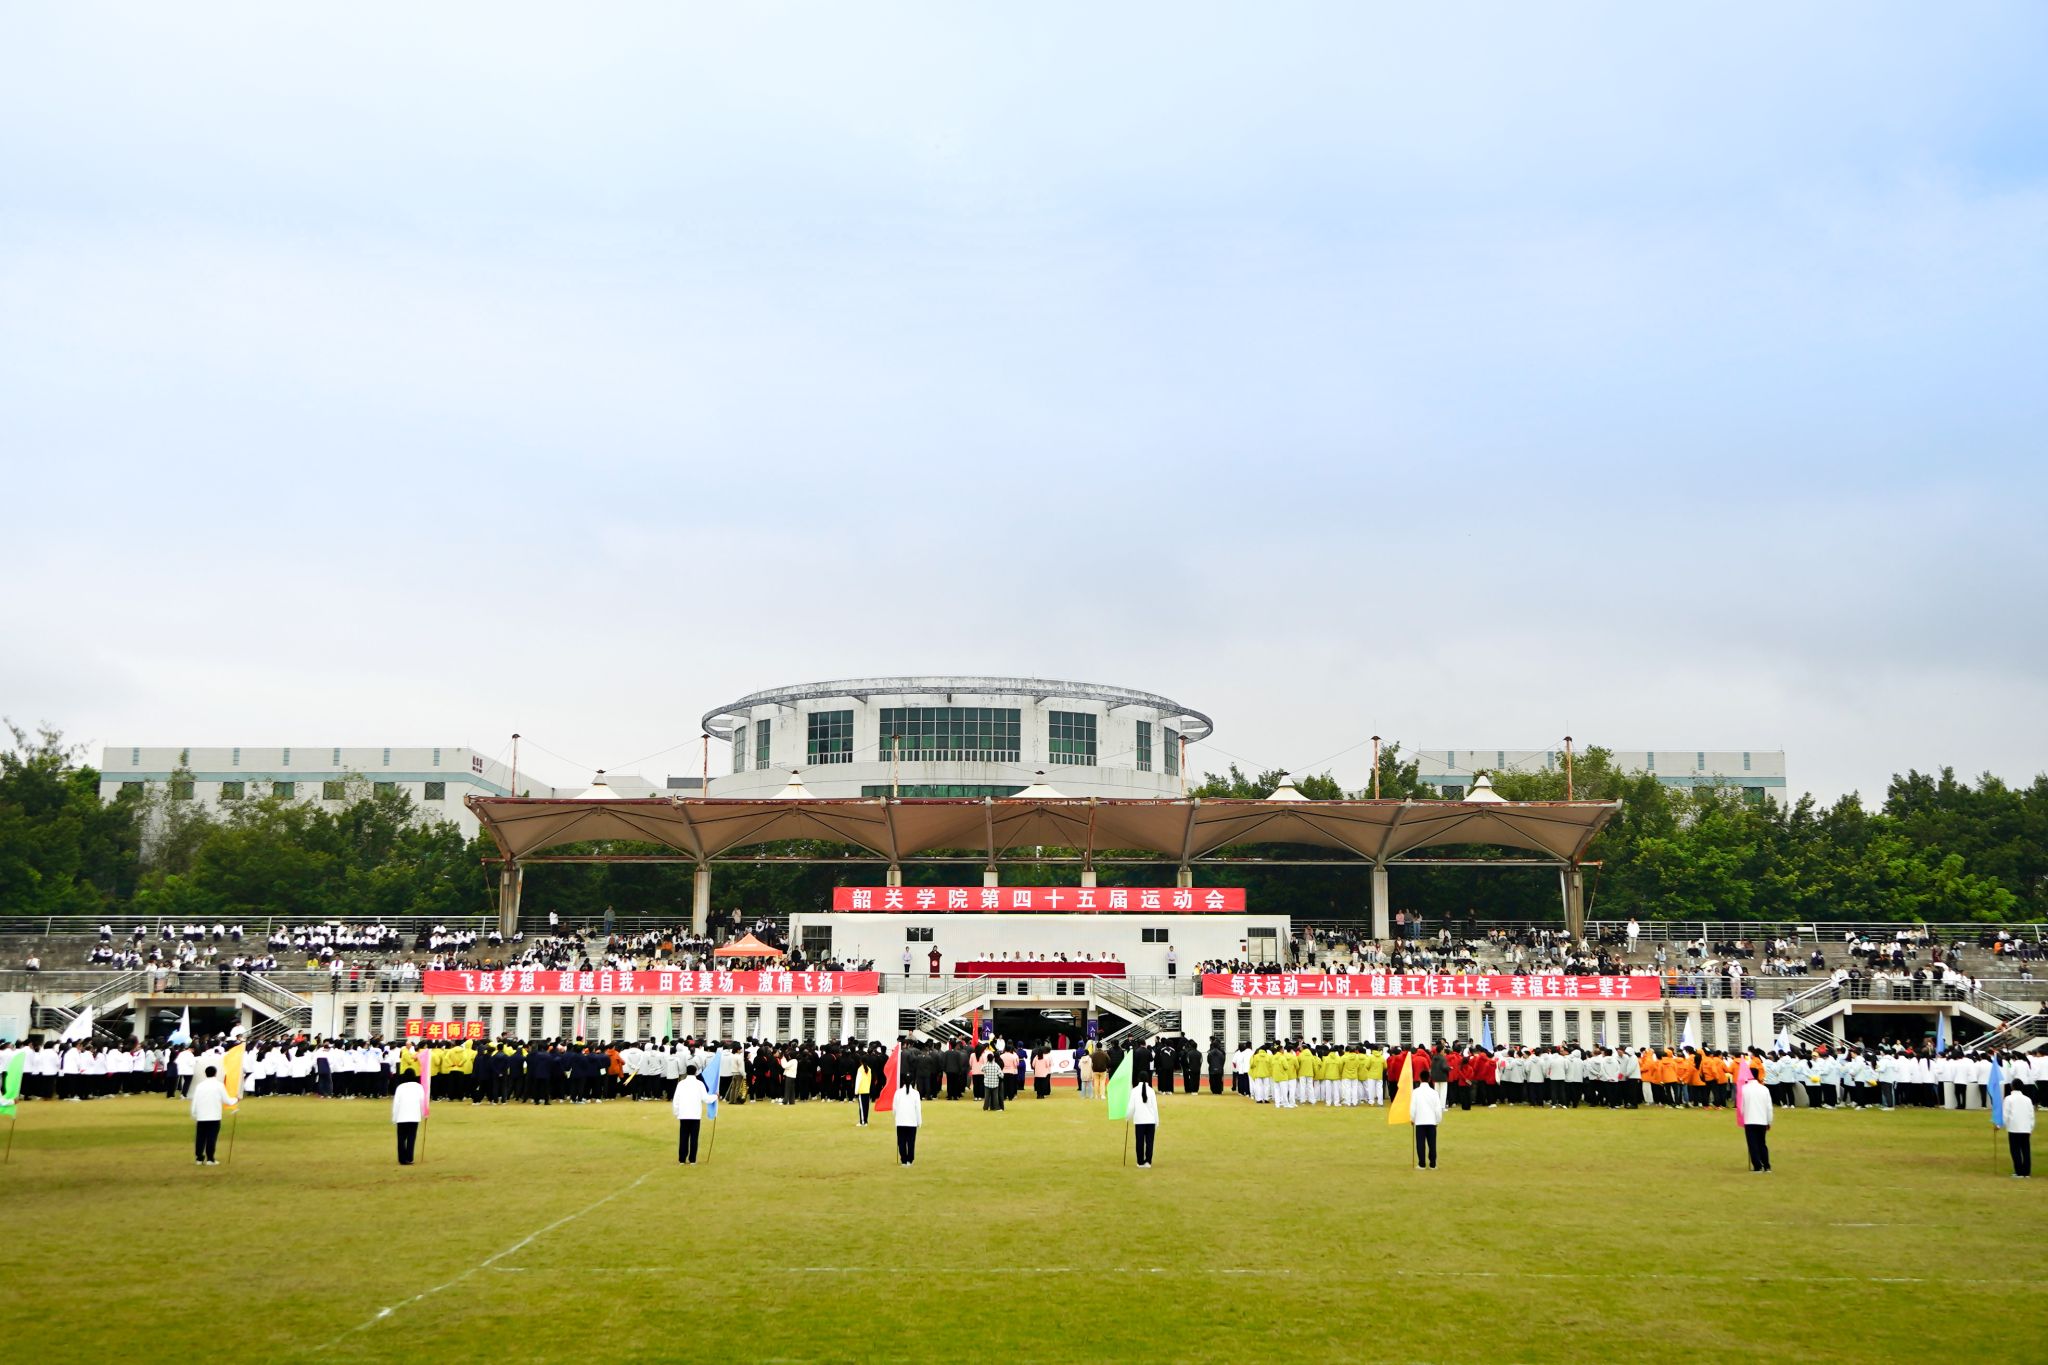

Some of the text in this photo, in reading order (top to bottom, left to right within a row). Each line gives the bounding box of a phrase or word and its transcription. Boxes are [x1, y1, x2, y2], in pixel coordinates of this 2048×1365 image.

[852, 889, 1225, 909] 韶关学院第四十五届运动会
[407, 1020, 481, 1038] 百年师范
